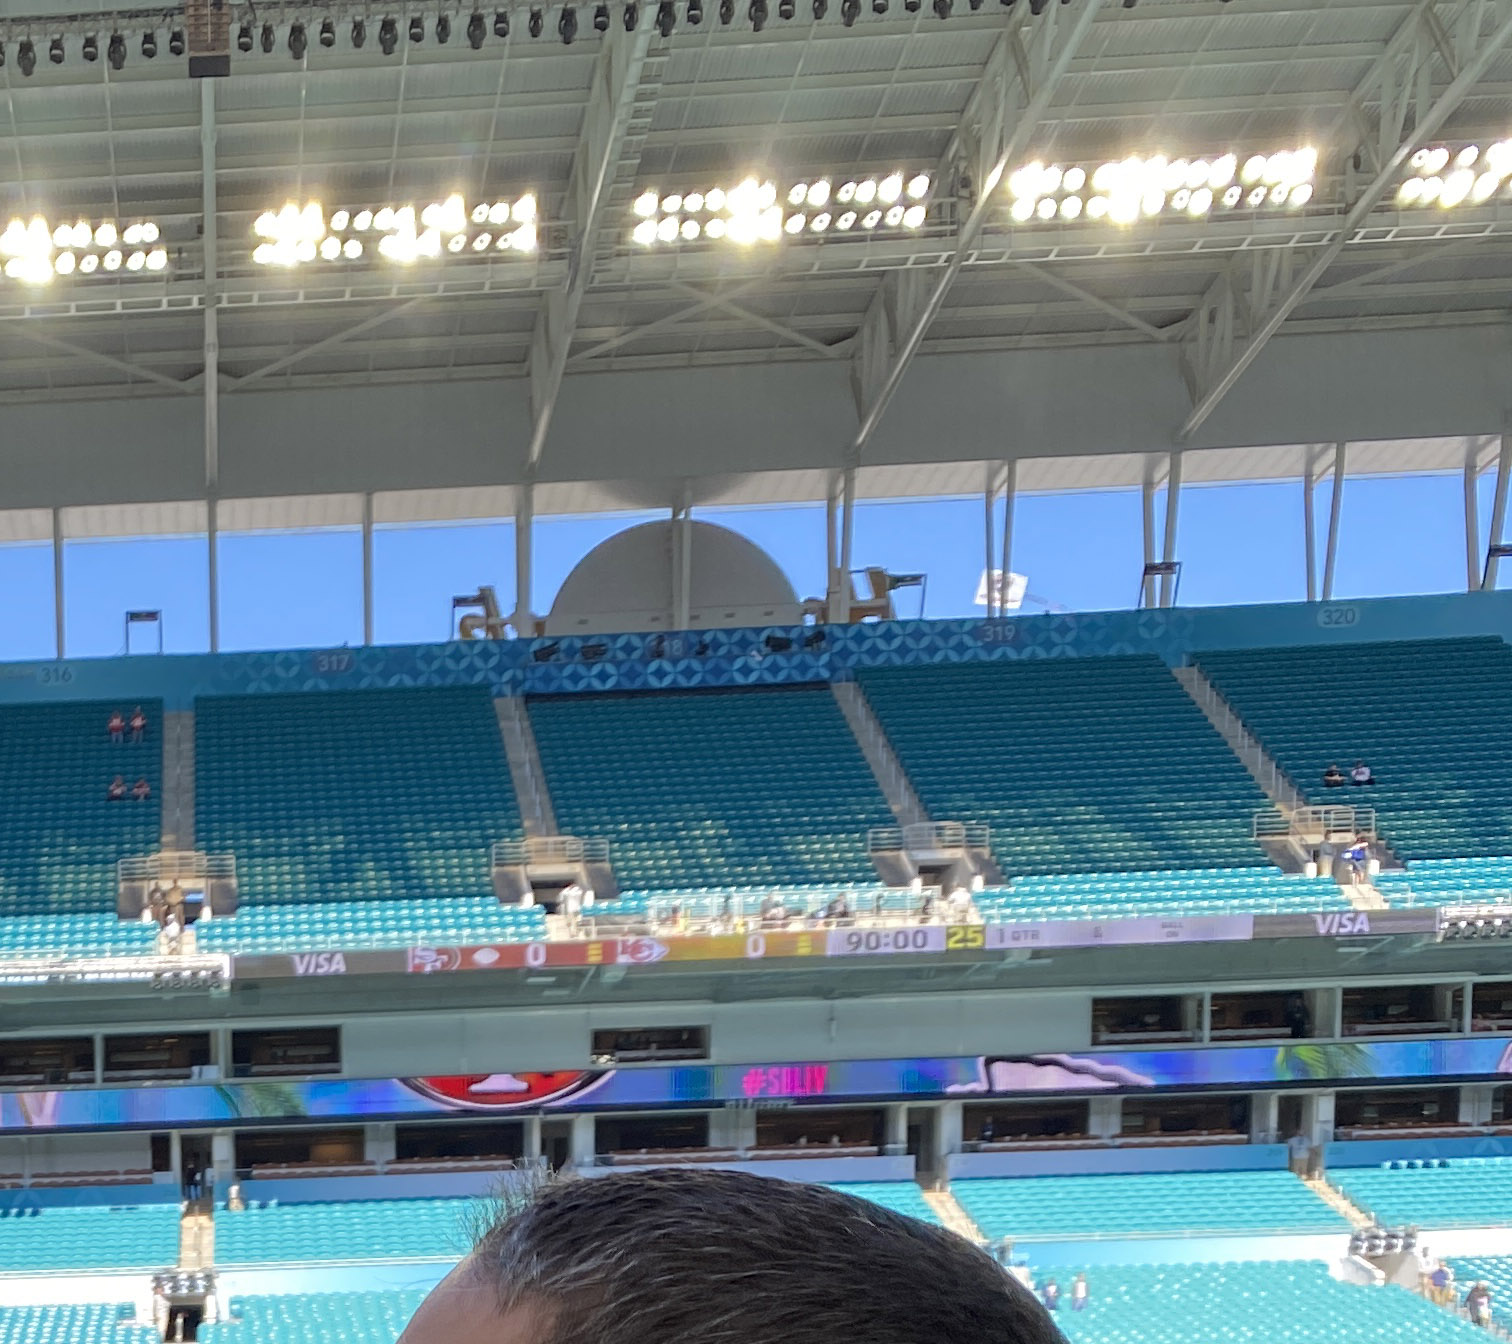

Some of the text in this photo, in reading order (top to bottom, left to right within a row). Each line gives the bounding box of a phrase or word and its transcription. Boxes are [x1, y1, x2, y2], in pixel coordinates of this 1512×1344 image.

[1323, 608, 1355, 625] 320
[984, 625, 1016, 642] 319
[317, 654, 351, 672] 317
[41, 665, 73, 684] 316
[1315, 912, 1370, 935] VISA
[526, 943, 546, 967] 0
[746, 935, 765, 957] 0
[846, 929, 929, 952] 90:00
[948, 926, 985, 948] 25
[292, 952, 347, 976] VISA
